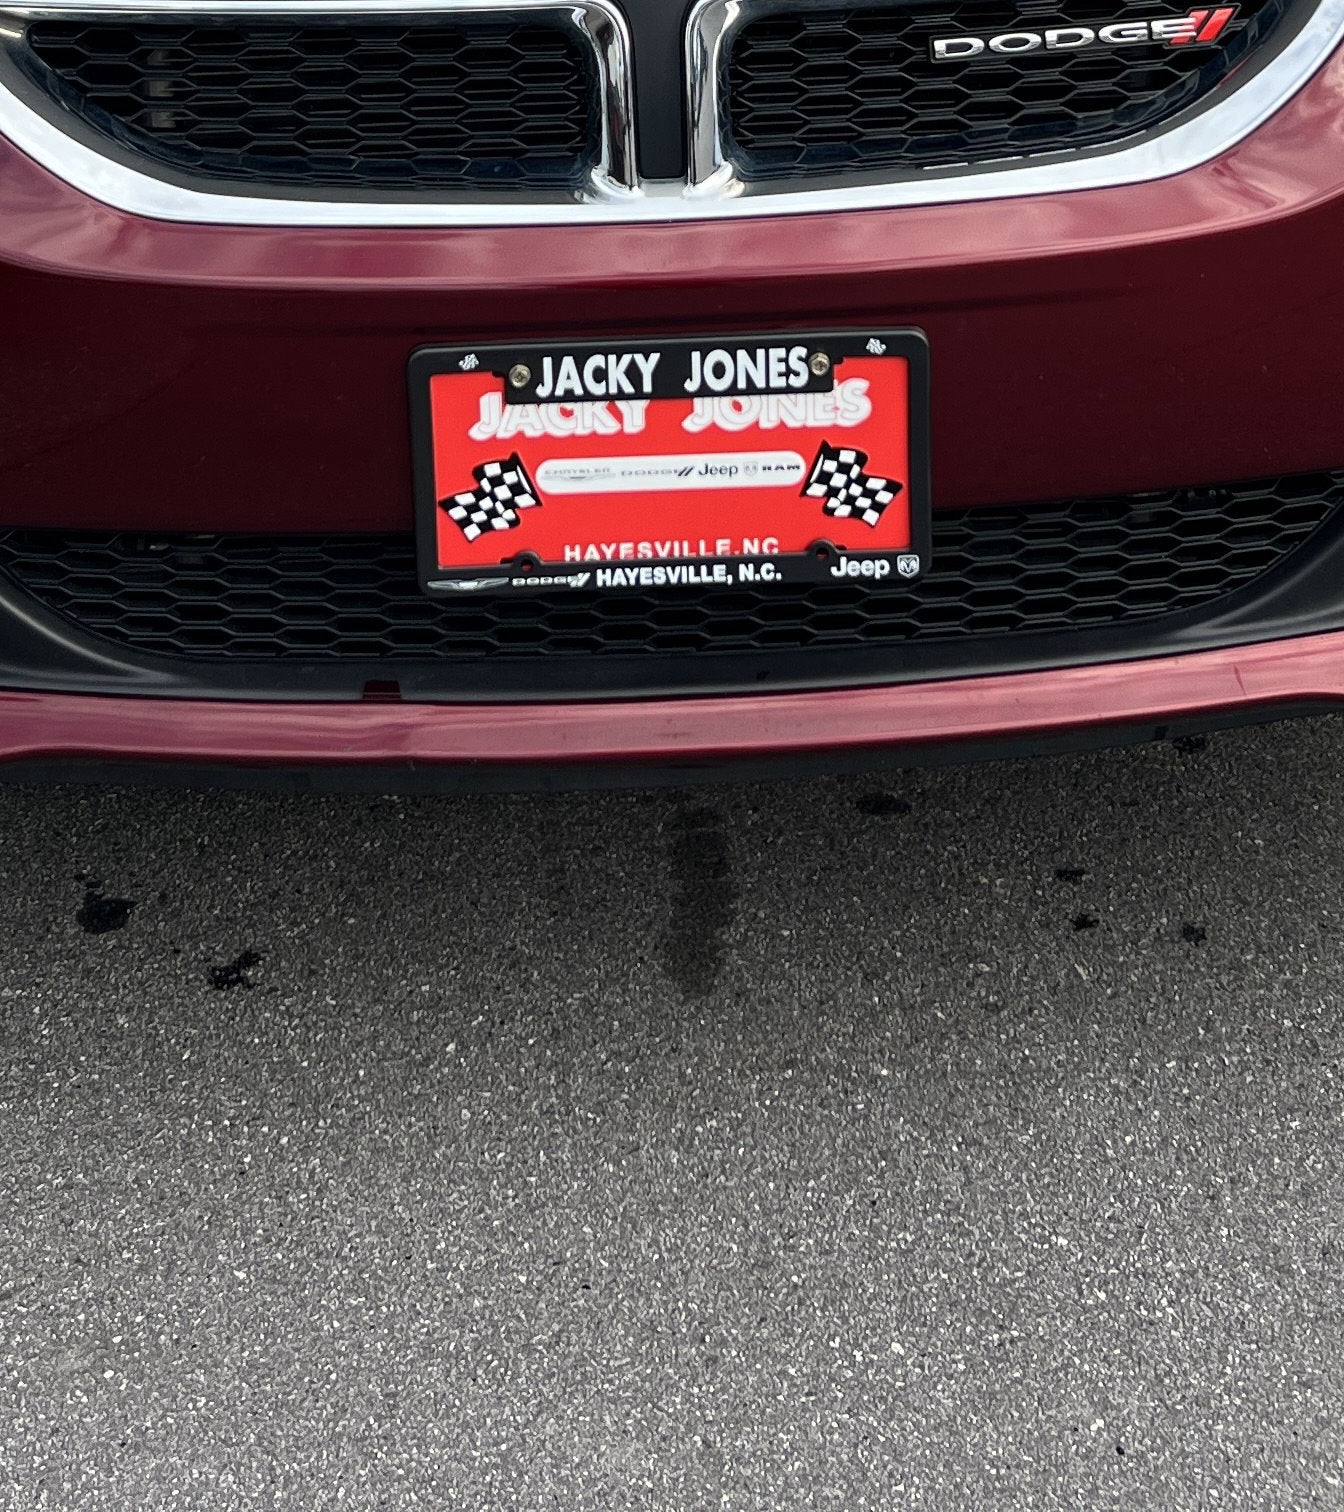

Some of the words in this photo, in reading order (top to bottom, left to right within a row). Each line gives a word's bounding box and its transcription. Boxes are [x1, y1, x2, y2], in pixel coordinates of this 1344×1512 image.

[933, 17, 1197, 59] DODGE
[535, 352, 661, 398] JACKY
[683, 345, 810, 395] JONES
[468, 391, 652, 441] JACKY
[681, 378, 873, 434] JONES
[698, 462, 739, 477] Jeep
[596, 563, 733, 586] HAYESVILLE,
[738, 562, 782, 583] N.C.
[830, 556, 890, 580] Jeep
